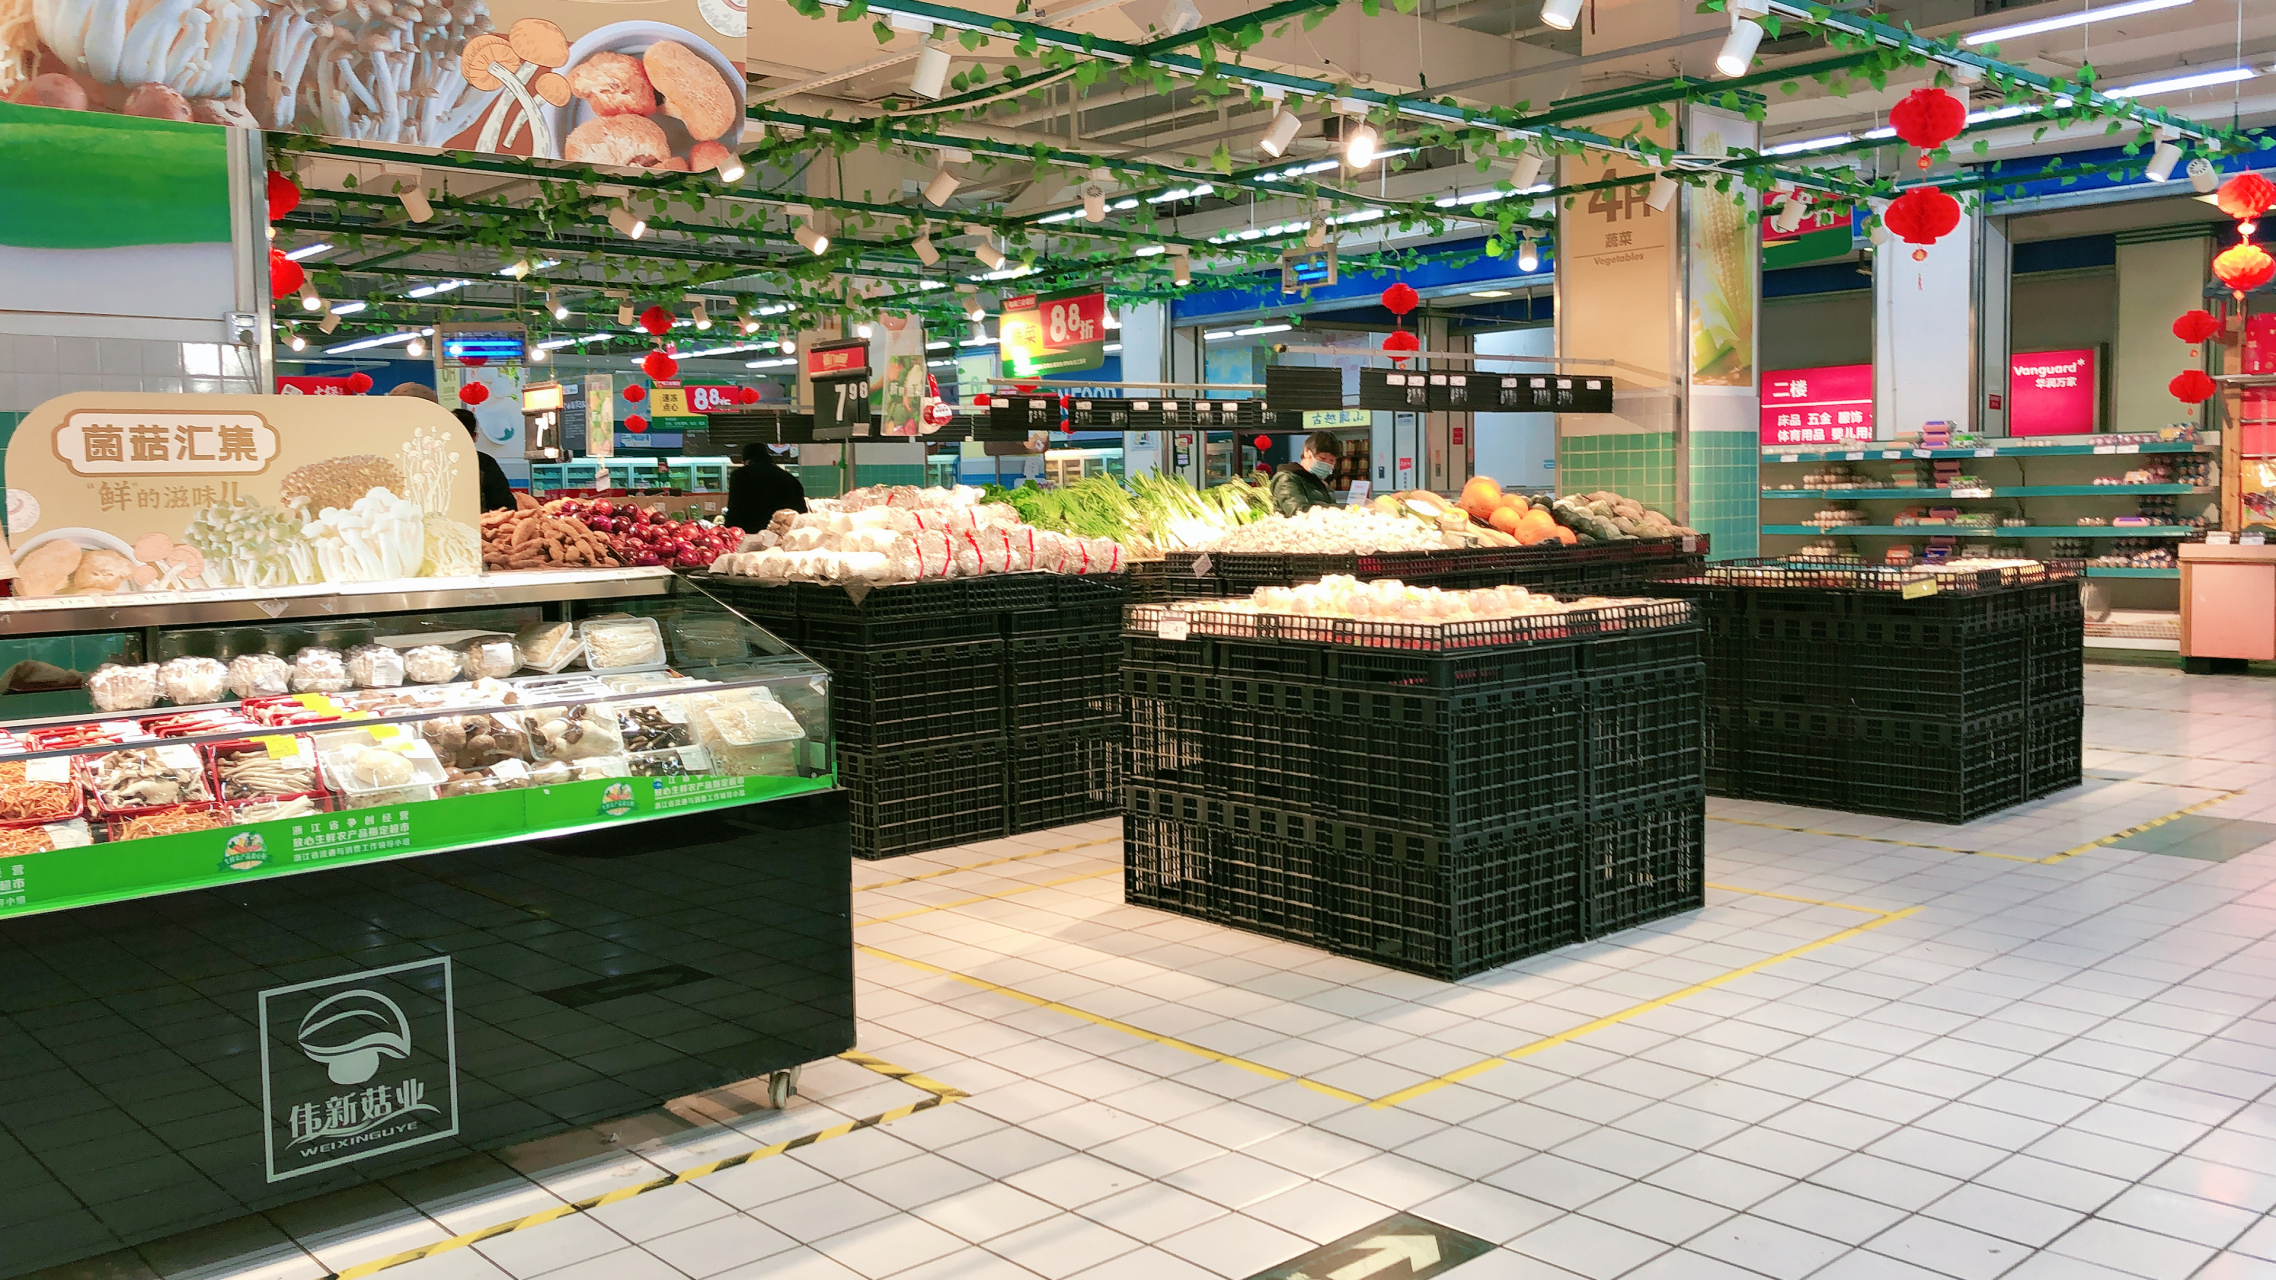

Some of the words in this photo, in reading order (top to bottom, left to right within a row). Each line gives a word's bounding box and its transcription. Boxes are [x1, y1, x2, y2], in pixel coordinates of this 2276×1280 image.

[1588, 168, 1651, 223] 4H
[1605, 231, 1633, 248] 蔬菜
[1593, 252, 1644, 267] Vegetables
[1050, 303, 1094, 342] 8.8折
[2013, 362, 2077, 377] Vanguard
[1772, 379, 1808, 398] 二楼
[2035, 376, 2077, 389] 华润万家
[1777, 413, 1802, 427] 床品
[1807, 411, 1832, 425] 五金
[1837, 410, 1863, 424] 服饰
[82, 424, 259, 462] 菌菇汇集
[1777, 428, 1825, 442] 体育用品
[293, 823, 409, 848] 放心生鲜农产品指定超市
[289, 1078, 425, 1139] 伟新菇业
[300, 1121, 418, 1158] WEIXINGUYE
